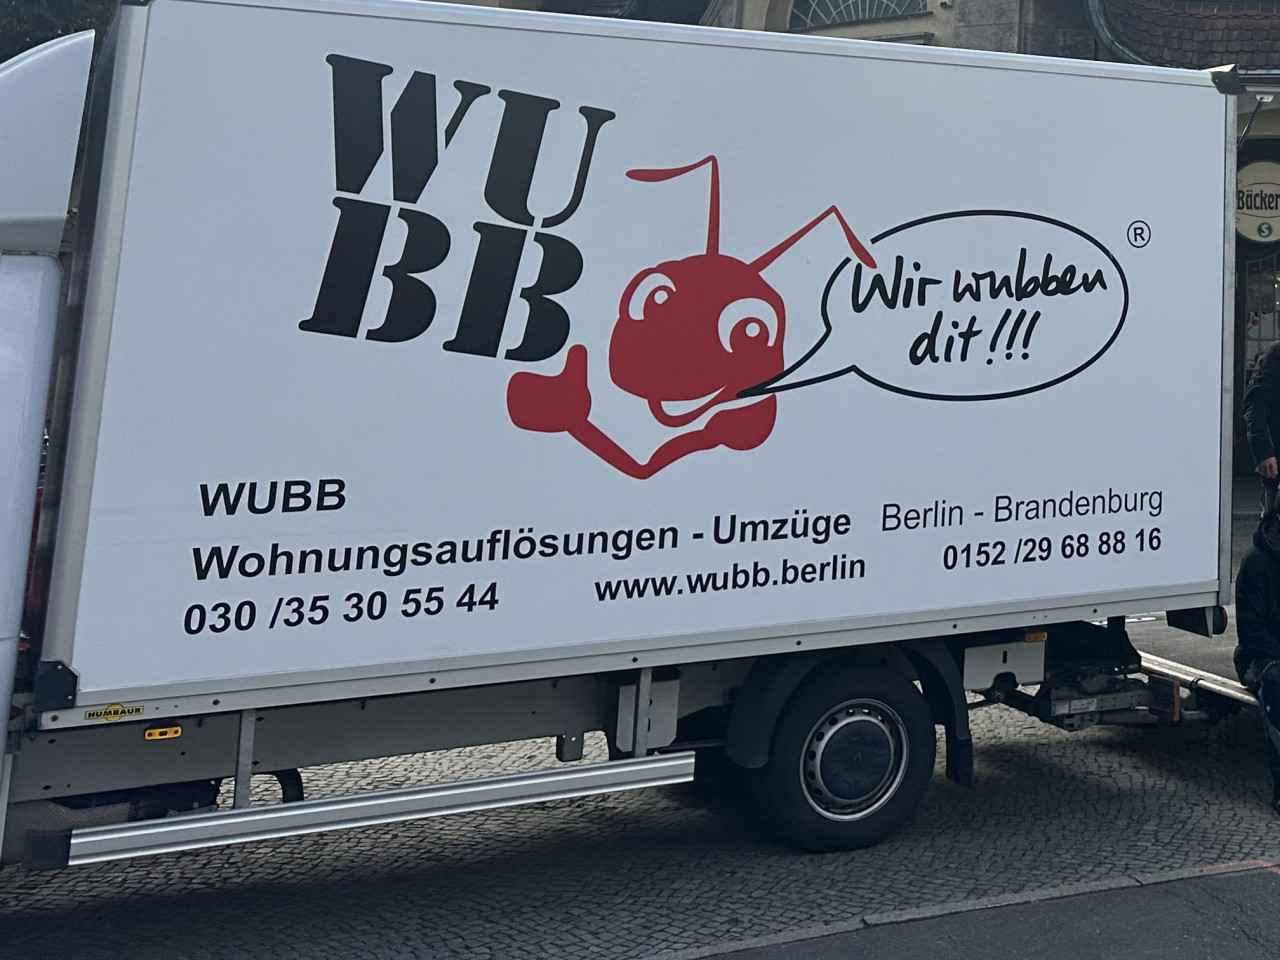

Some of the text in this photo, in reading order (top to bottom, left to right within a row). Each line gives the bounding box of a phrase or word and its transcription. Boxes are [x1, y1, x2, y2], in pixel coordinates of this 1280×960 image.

[326, 53, 616, 228] WU
[299, 196, 584, 362] BB
[852, 248, 1107, 313] Wir wubben
[193, 526, 679, 580] Wohnungsauflösungen
[713, 509, 851, 544] Umzüge
[882, 499, 964, 532] Berlin
[994, 488, 1163, 522] Brandenburg
[200, 478, 346, 517] WUBB
[184, 600, 257, 635] 030
[343, 590, 387, 622] 30
[401, 586, 445, 617] 55
[456, 581, 499, 612] 44
[594, 553, 865, 602] www.wubb.berlin
[943, 540, 1006, 570] 0152
[1061, 533, 1089, 559] 68
[1098, 530, 1126, 555] 88
[1135, 527, 1162, 552] 16
[88, 707, 142, 718] HUMBAUR
